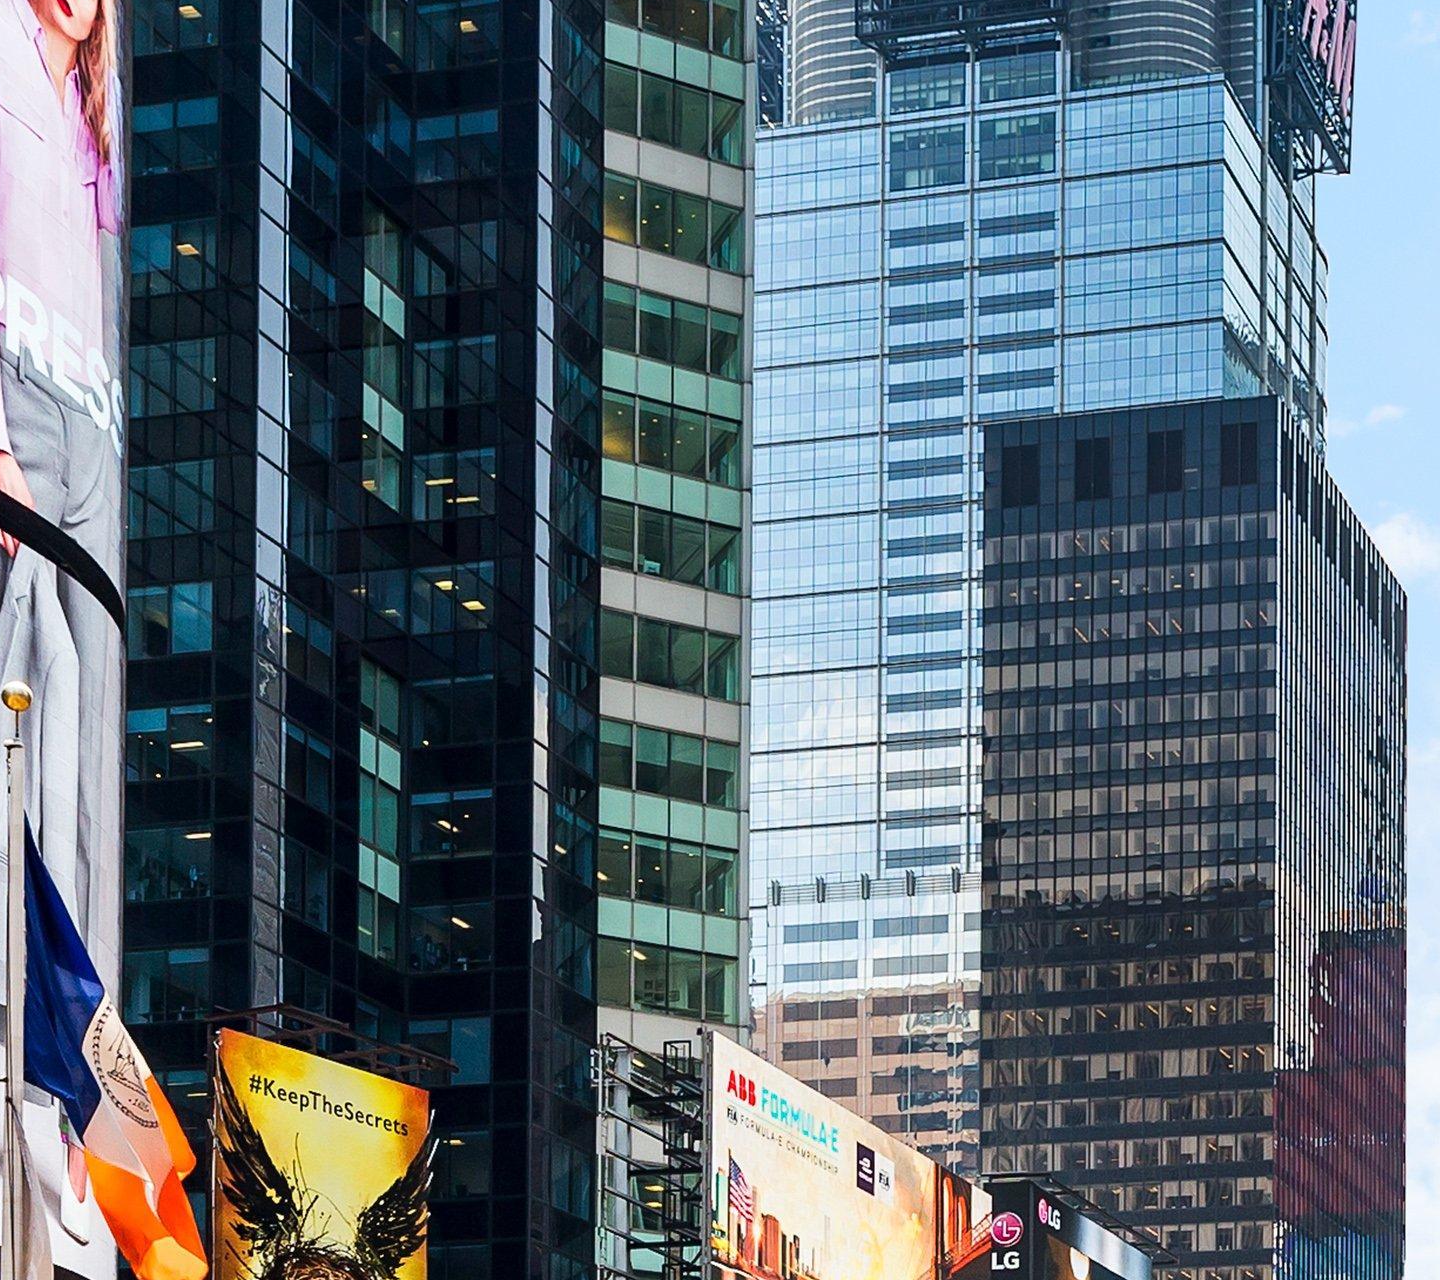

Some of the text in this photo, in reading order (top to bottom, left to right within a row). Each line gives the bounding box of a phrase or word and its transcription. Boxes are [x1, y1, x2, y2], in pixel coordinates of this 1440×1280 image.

[249, 1073, 409, 1137] #KeepTheSecrets
[727, 1069, 756, 1107] ABB
[991, 1250, 1020, 1270] LG
